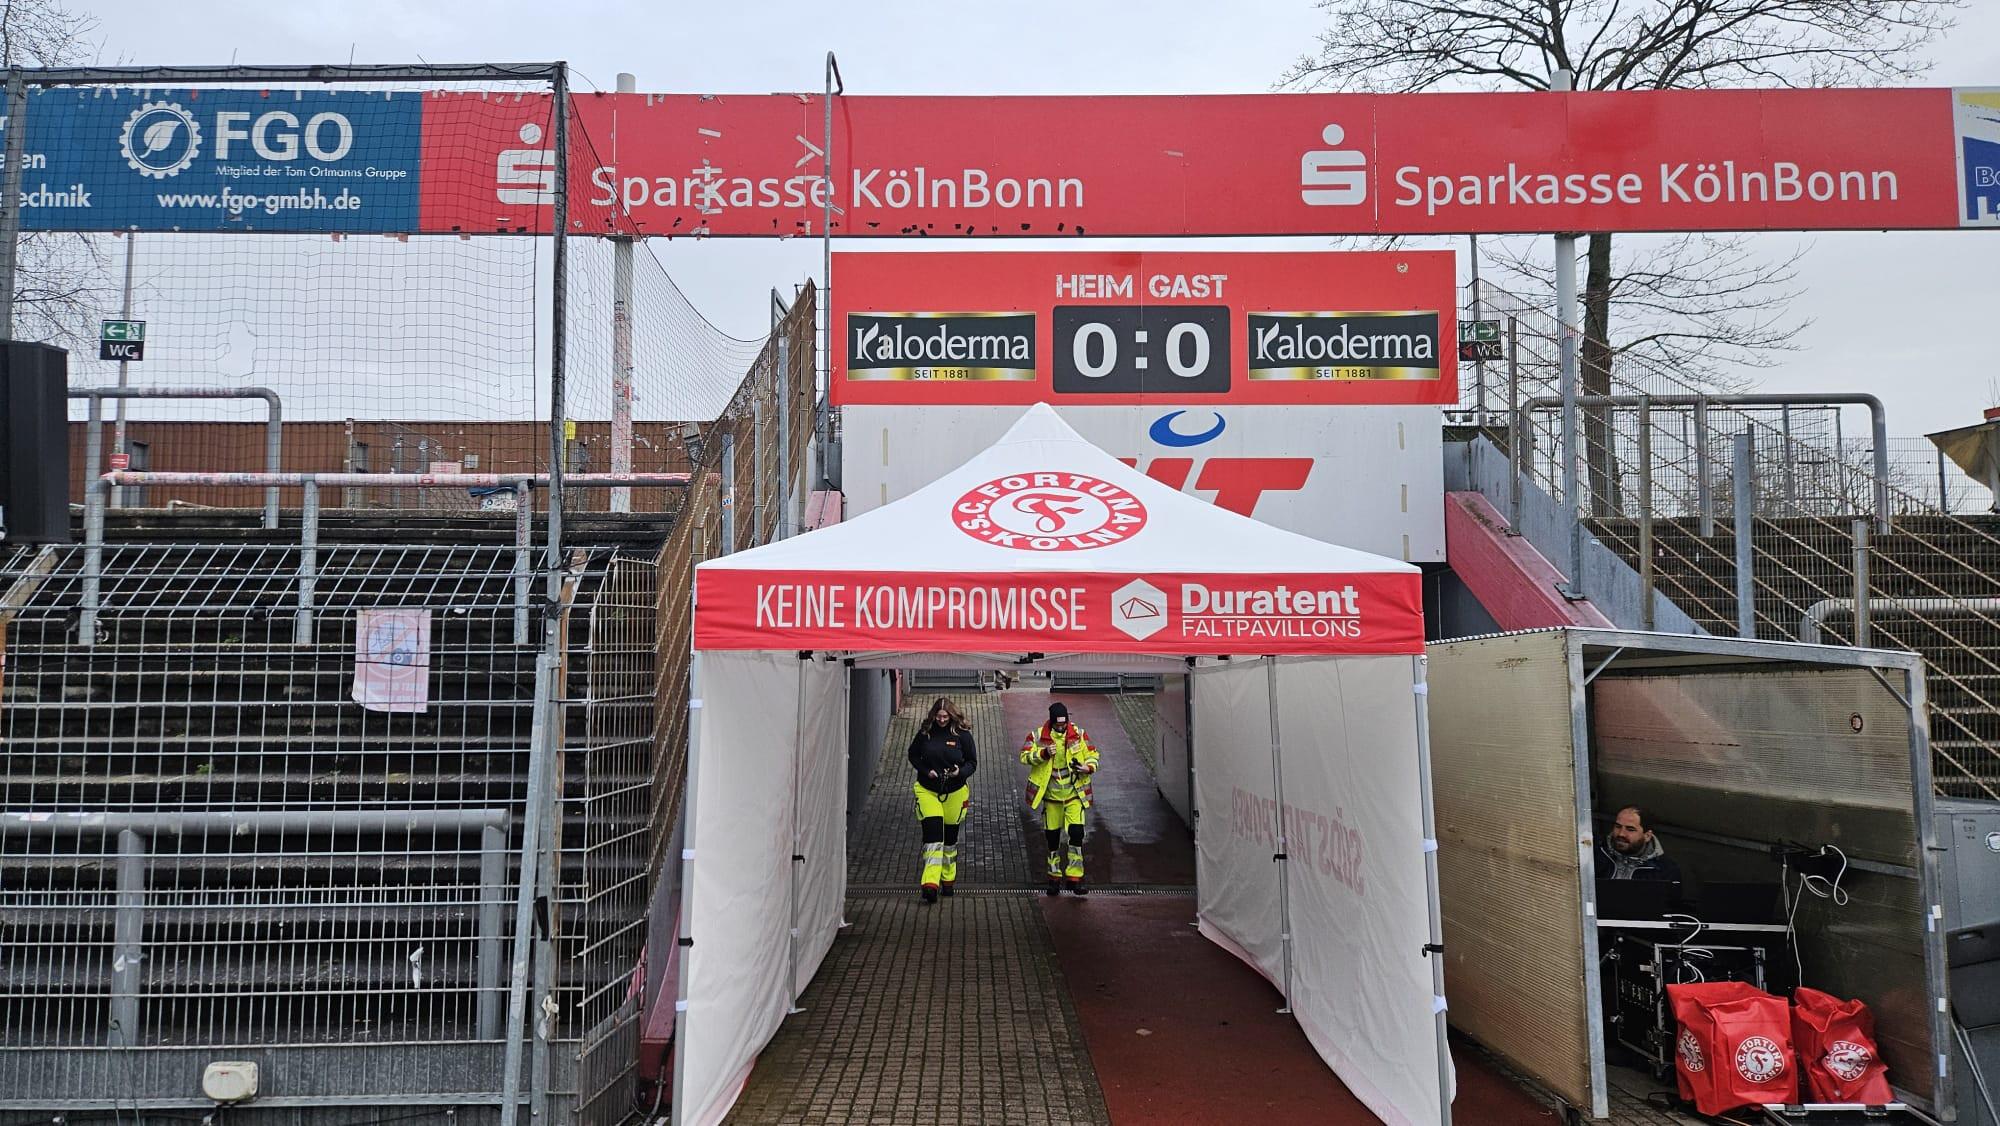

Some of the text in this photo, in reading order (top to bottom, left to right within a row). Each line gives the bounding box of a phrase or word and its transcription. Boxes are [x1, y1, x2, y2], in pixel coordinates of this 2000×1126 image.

[215, 111, 353, 161] FGO
[216, 165, 260, 178] Mitglied
[263, 165, 282, 176] der
[285, 166, 306, 176] Tom
[365, 166, 407, 180] Gruppe
[157, 187, 361, 214] www.fgo-gmbh.de
[591, 166, 1084, 217] Sparkasse KölnBonn
[1395, 160, 1898, 215] Sparkasse KölnBonn
[1056, 274, 1228, 298] HEIM GAST
[109, 344, 136, 357] WC
[855, 322, 1030, 363] Kaloderma
[1255, 321, 1433, 362] Kaloderma
[1477, 343, 1501, 357] WC
[914, 369, 969, 379] SEIT 1881
[1316, 369, 1372, 378] SEIT 1881
[756, 584, 1087, 631] KEINE KOMPROMISSE
[1181, 583, 1361, 614] Duratent
[1182, 619, 1361, 637] FALTPAVILLONS
